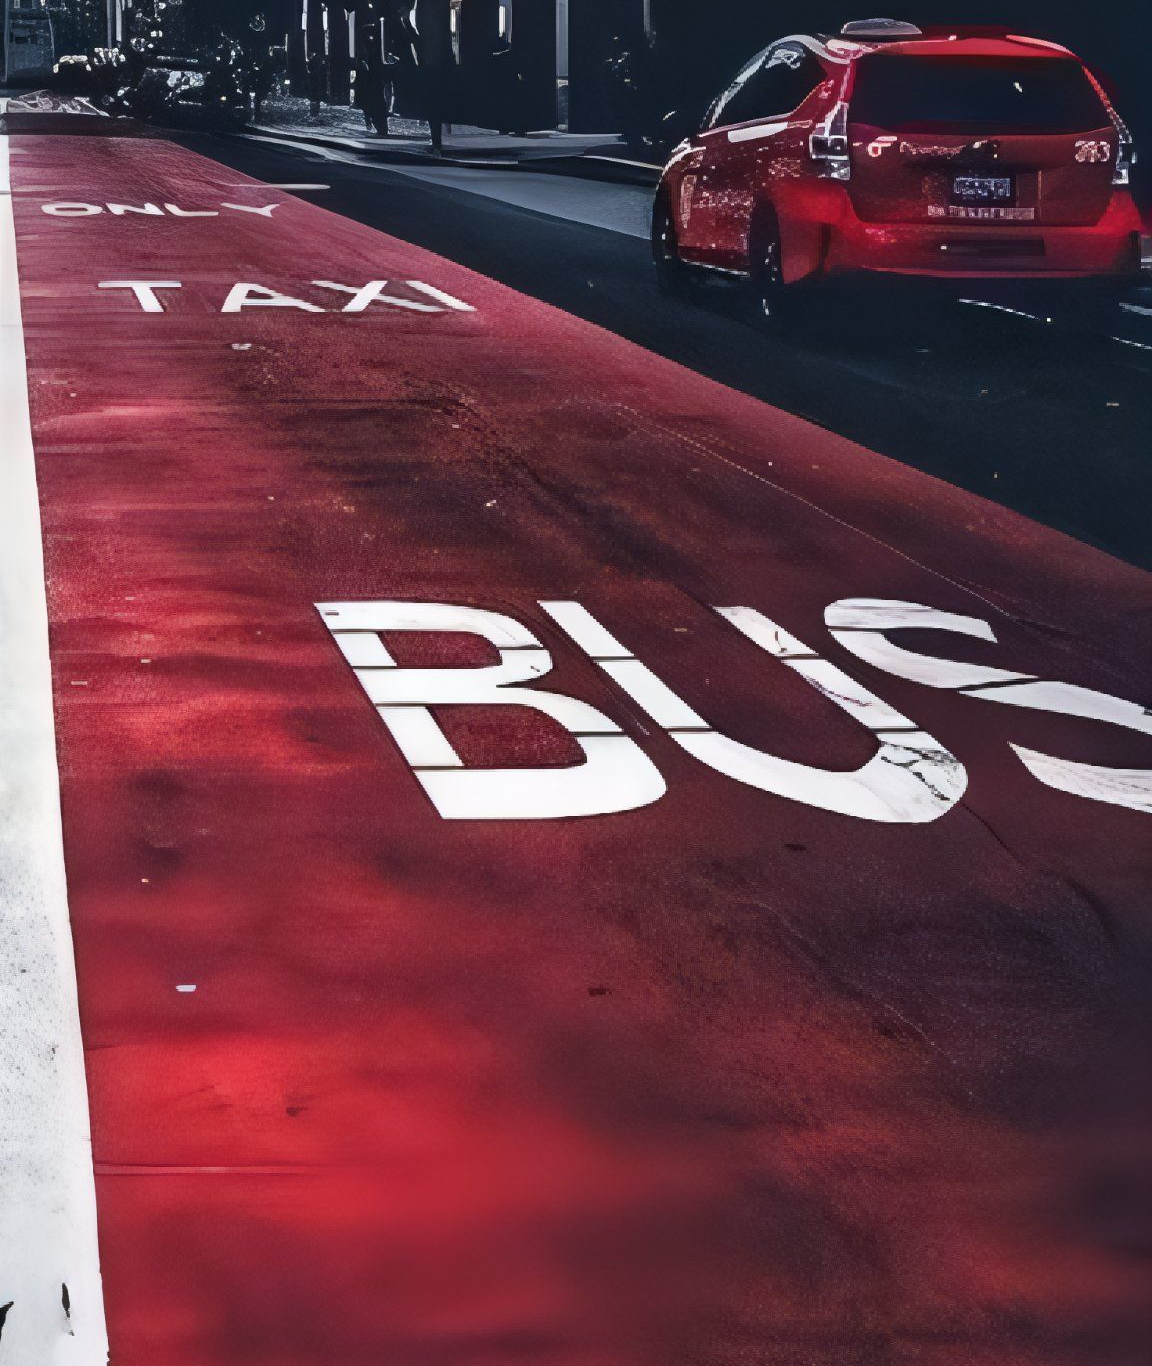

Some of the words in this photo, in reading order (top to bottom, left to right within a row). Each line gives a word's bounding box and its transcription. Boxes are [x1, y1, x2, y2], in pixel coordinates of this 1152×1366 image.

[40, 202, 281, 218] ONLY
[98, 280, 478, 313] TAXI
[313, 598, 1152, 823] BUS
